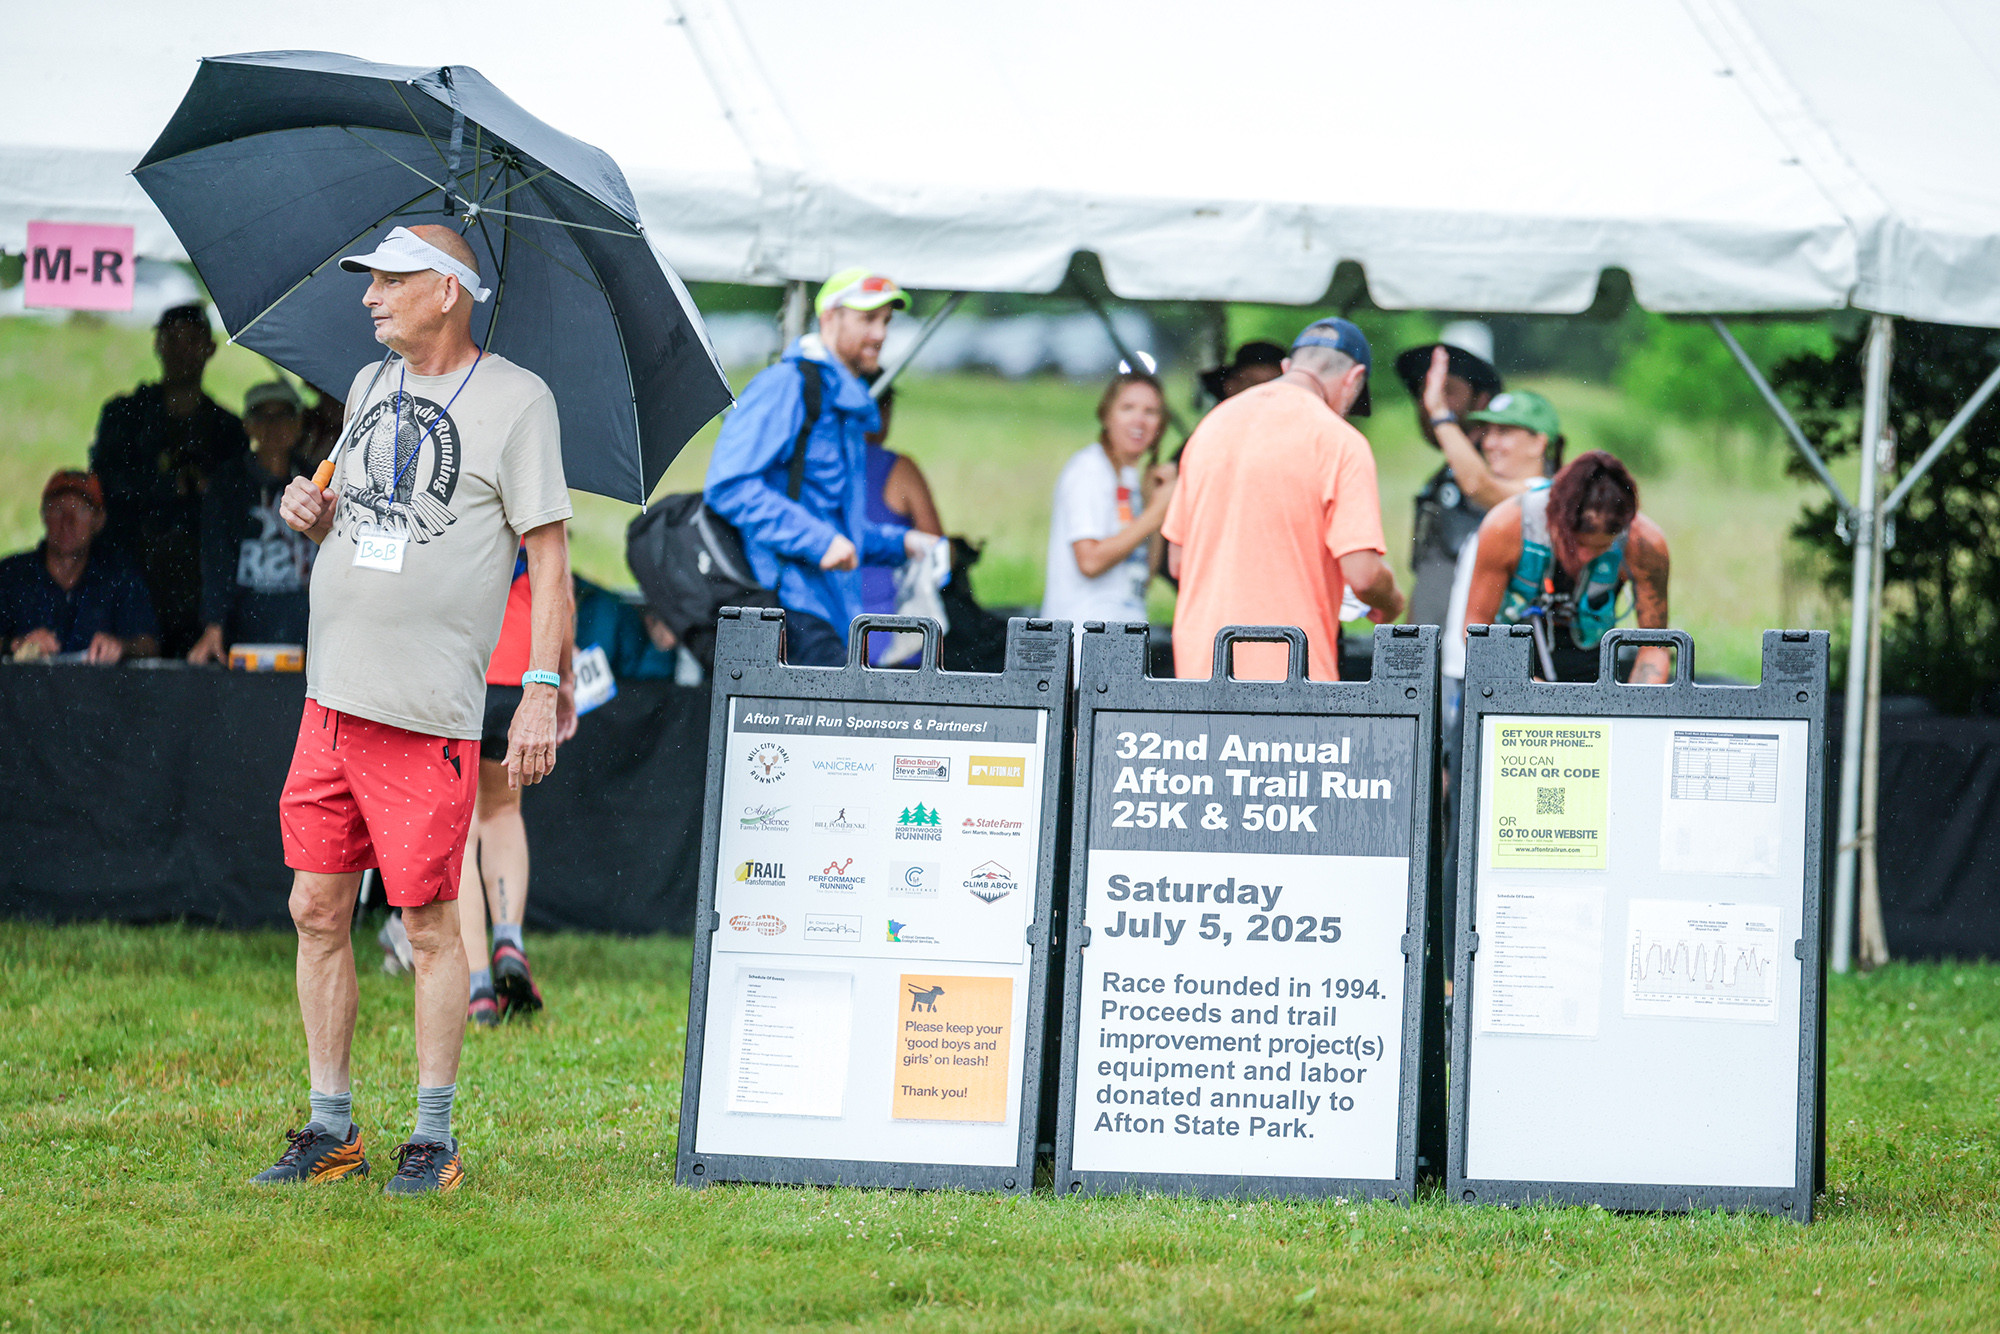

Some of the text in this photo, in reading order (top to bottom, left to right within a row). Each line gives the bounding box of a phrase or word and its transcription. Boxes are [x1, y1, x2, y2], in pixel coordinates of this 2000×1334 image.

[31, 246, 123, 285] M-R
[353, 409, 382, 439] Roc
[434, 418, 457, 498] Running
[743, 713, 988, 733] Afton Trail Run Sponsors & Partners!
[1502, 729, 1601, 739] GET YOUR RESULTS
[1115, 731, 1351, 764] 32nd Annual
[1502, 738, 1593, 748] ON YOUR PHONE...
[747, 747, 760, 762] MILL
[776, 745, 790, 763] TRAIL
[1501, 755, 1554, 766] YOU CAN
[812, 760, 875, 772] VANICREAM
[917, 759, 941, 768] Realty
[749, 770, 786, 784] RUNNING
[895, 767, 915, 775] Steve
[1501, 768, 1600, 778] SCAN QR CODE
[1112, 766, 1392, 800] Afton Trail Run
[760, 817, 789, 826] Science
[1111, 800, 1319, 833] 25K & 50K
[1499, 816, 1517, 826] OR
[740, 824, 790, 833] Family Dentistry
[895, 826, 943, 834] NORTHWOODS
[1499, 828, 1598, 839] GO TO OUR WEBSITE
[895, 832, 942, 841] RUNNING
[745, 862, 786, 879] TRAIL
[745, 878, 785, 886] Transformation
[808, 875, 866, 884] PERFORMANCE
[819, 882, 854, 890] RUNNING
[963, 880, 988, 888] CLIMB
[1106, 874, 1283, 912] Saturday
[1104, 911, 1342, 947] July 5, 2025
[1102, 971, 1387, 1000] Race founded in 1994.
[1101, 1000, 1337, 1027] Proceeds and trail
[905, 1020, 1004, 1036] Please keep your
[941, 1038, 971, 1052] boys
[973, 1040, 997, 1051] and
[1099, 1028, 1385, 1061] improvement project(s)
[934, 1056, 950, 1065] on
[953, 1055, 989, 1066] leash!
[1097, 1057, 1368, 1084] equipment and labor
[901, 1085, 968, 1100] Thank you!
[1096, 1084, 1355, 1116] donated annually to
[1093, 1112, 1315, 1139] Afton State Park.
